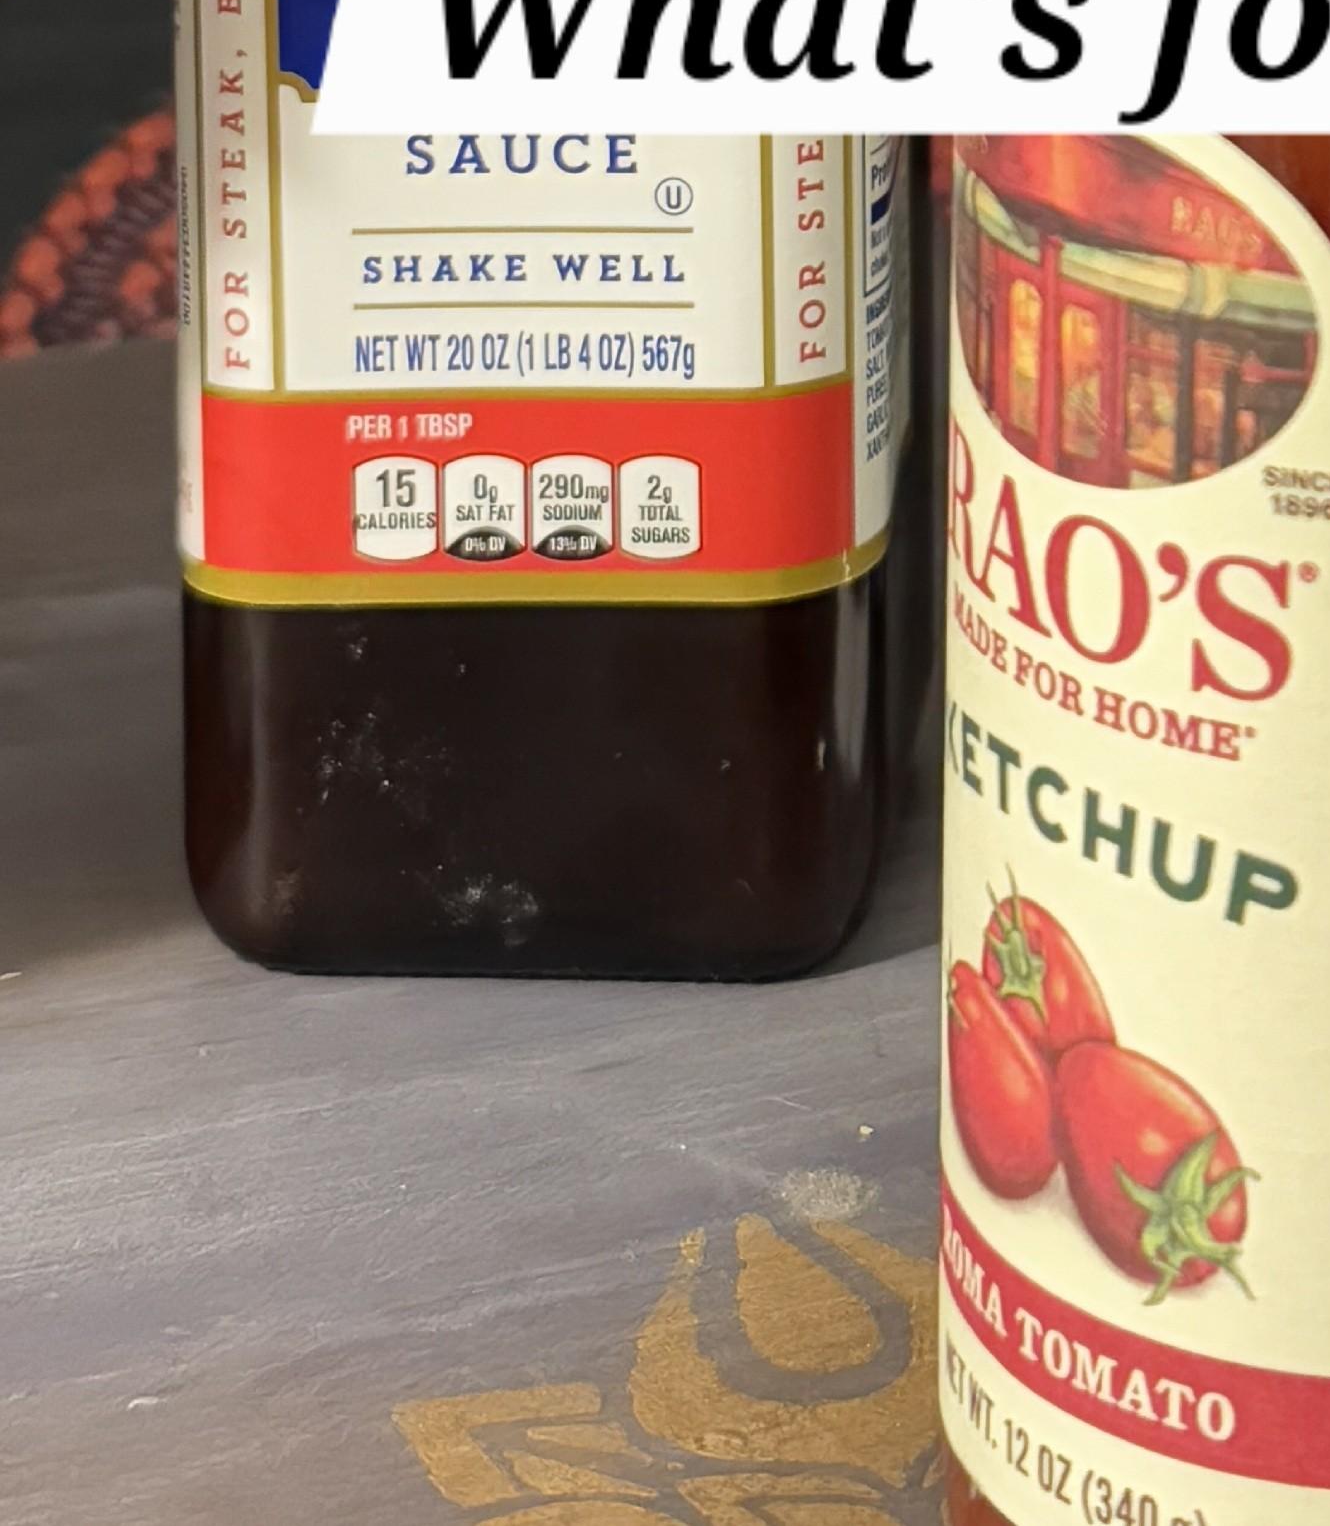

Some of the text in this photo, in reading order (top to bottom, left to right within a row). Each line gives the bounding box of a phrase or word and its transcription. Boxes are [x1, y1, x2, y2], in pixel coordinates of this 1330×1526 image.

[219, 49, 248, 238] STEAK,
[405, 134, 639, 175] SAUCE
[363, 254, 687, 284] SHAKE WELL
[223, 271, 251, 370] FOR
[799, 262, 828, 363] FOR
[355, 333, 695, 379] NET WT 20 OZ (1 LB 4 OZ) 567g
[346, 413, 473, 441] PER 1 TBSP
[376, 468, 417, 508] 15
[474, 473, 498, 506] 0g
[539, 473, 609, 503] 290mg
[647, 475, 672, 505] 2g
[357, 512, 437, 530] CALORIES
[456, 504, 516, 522] SAT FAT
[543, 504, 602, 522] SODIUM
[638, 505, 683, 522] TOTAL
[488, 536, 506, 552] DV
[578, 536, 597, 552] DV
[631, 527, 690, 544] SUGARS
[953, 580, 1008, 673] MADE
[1012, 645, 1086, 717] FOR
[1014, 1307, 1236, 1442] TOMATO
[968, 1372, 998, 1449] WT.
[1004, 1418, 1029, 1477] 12
[1037, 1445, 1073, 1506] OZ
